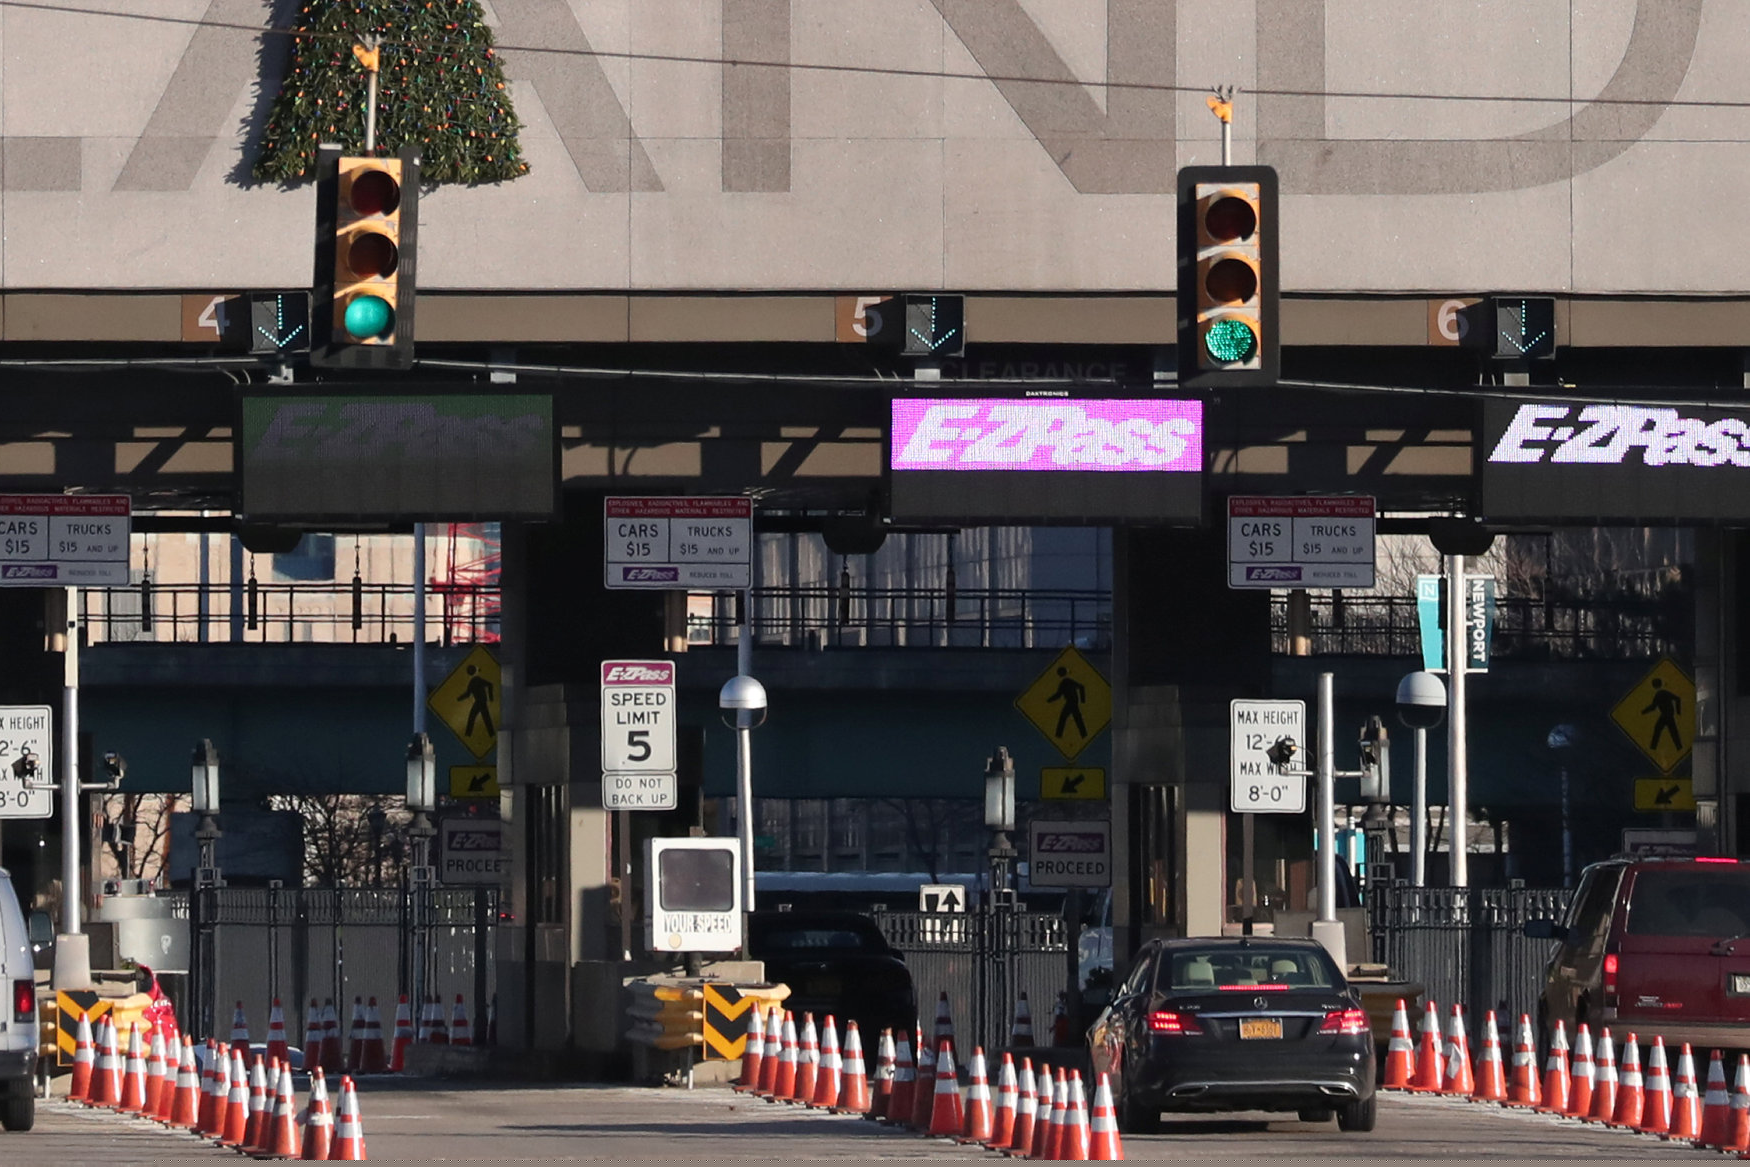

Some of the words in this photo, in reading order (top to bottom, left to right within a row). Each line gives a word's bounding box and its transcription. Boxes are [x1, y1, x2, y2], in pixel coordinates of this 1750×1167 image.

[198, 296, 230, 335] 4
[852, 296, 883, 337] 5
[1437, 299, 1469, 341] 6
[900, 405, 1195, 466] E-ZPass
[1488, 405, 1750, 466] E-ZPas
[66, 524, 111, 535] TRUCKS
[618, 524, 658, 538] CARS
[687, 526, 732, 537] TRUCKS
[1241, 523, 1281, 537] CARS
[1310, 525, 1356, 537] TRUCKS
[5, 538, 30, 555] $15
[59, 541, 77, 553] $15
[87, 545, 103, 553] AND
[108, 545, 118, 553] UP
[626, 541, 651, 557] $15
[680, 543, 698, 555] $15
[707, 547, 724, 555] AND
[728, 547, 739, 555] UP
[1249, 540, 1274, 558] $15
[1303, 543, 1322, 555] $15
[1472, 579, 1486, 662] NEWPORT
[606, 666, 670, 681] E-ZPass
[611, 693, 666, 706] SPEED
[10, 717, 45, 730] HEIGHT
[617, 711, 660, 724] LIMIT
[1238, 711, 1258, 724] MAX
[1264, 711, 1298, 724] HEIGHT
[627, 731, 651, 761] 5
[1240, 762, 1261, 775] MAX
[1267, 762, 1297, 775] WIH
[616, 778, 632, 789] DO
[640, 778, 662, 789] NOT
[612, 794, 643, 804] BACK
[652, 794, 667, 804] UP
[1249, 785, 1288, 802] 8'-0"
[447, 859, 501, 872] PROCEE
[1036, 861, 1105, 874] PROCEED
[664, 914, 694, 933] YOUR
[697, 914, 732, 933] SPEED
